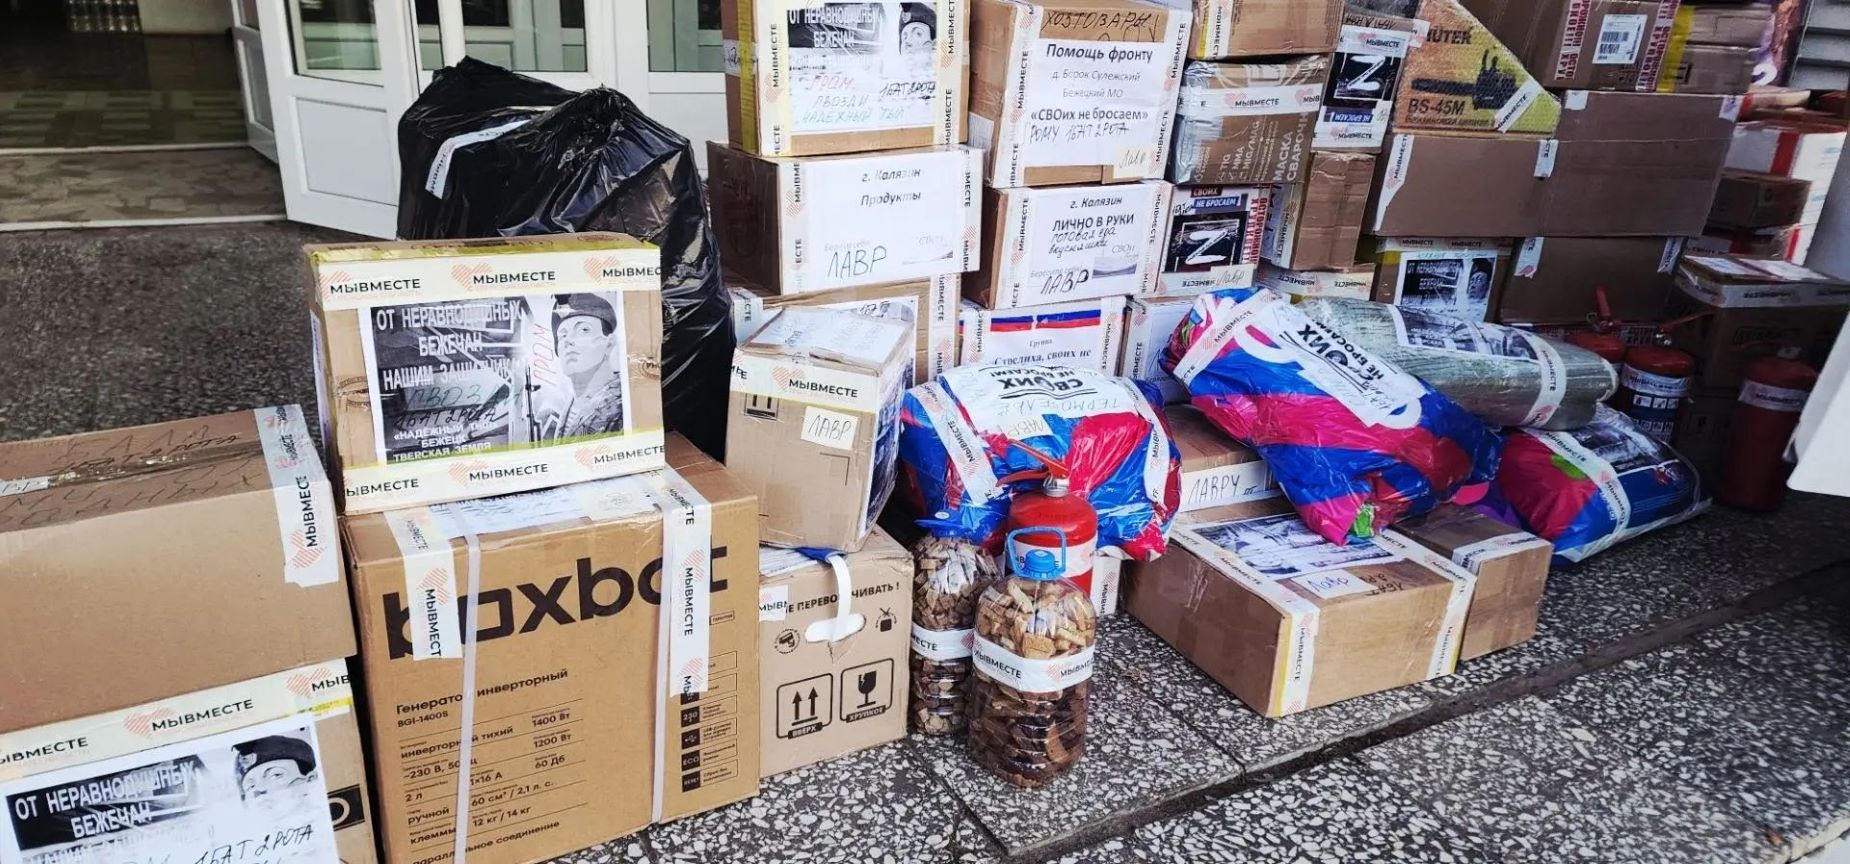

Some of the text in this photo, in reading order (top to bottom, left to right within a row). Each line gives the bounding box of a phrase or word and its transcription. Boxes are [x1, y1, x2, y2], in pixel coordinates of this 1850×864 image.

[1046, 43, 1154, 64] Помощь фронту
[1171, 22, 1187, 79] МЫВМЕСТЕ
[1366, 39, 1400, 48] МЫВМЕСТЕ
[771, 23, 780, 88] МЫВМЕСТЕ
[1017, 50, 1029, 109] МЫВМЕСТЕ
[1107, 89, 1125, 99] МО
[1234, 98, 1280, 107] МЫВМЕСТЕ
[1031, 106, 1149, 123] «СВОих не бросаем»
[1408, 98, 1466, 117] BS-45M
[1155, 109, 1170, 162] МЫВМЕСТЕ
[1243, 120, 1261, 171] MIG/MAG
[1220, 153, 1232, 171] TIG
[1231, 146, 1245, 170] MMA
[1273, 131, 1294, 182] МАСКА
[862, 172, 871, 183] г.
[860, 191, 922, 207] Продукты
[1070, 197, 1123, 209] г. Калязин
[1196, 199, 1206, 208] НЕ
[1018, 197, 1030, 251] МЫВМЕСТЕ
[1052, 213, 1135, 232] ЛИЧНО В РУКИ
[827, 245, 887, 280] ЛАВР
[330, 278, 421, 295] МЫВМЕСТЕ
[473, 271, 556, 285] МЫВМЕСТЕ
[1040, 269, 1090, 295] ЛАВР
[377, 309, 395, 331] ОТ
[1214, 311, 1254, 344] МЫВМЕСТЕ
[419, 332, 483, 357] БЕЖЕЧАН
[1029, 338, 1054, 349] Группа
[1049, 350, 1076, 361] своих
[1077, 348, 1092, 359] не
[382, 364, 434, 391] НАШИМ
[1366, 364, 1385, 380] НЕ
[788, 377, 859, 399] МЫВМЕСТЕ
[807, 414, 852, 441] ЛАВР
[421, 435, 467, 449] БЕЖЕЦК
[946, 420, 975, 464] МЫВМЕСТЕ
[393, 447, 451, 462] ТВЕРСКАЯ
[346, 478, 420, 497] ЫВМЕСТЕ
[469, 463, 549, 482] МЫВМЕСТЕ
[1190, 474, 1241, 505] ЛАВРУ
[1220, 557, 1262, 585] МЫВМЕСТЕ
[683, 566, 695, 637] МЫВМЕСТЕ
[797, 584, 895, 611] ПЕРЕВОЧИВАТЬ
[424, 588, 442, 658] МЫВМЕСТ
[974, 650, 1022, 680] МЫВМЕСТЕ
[396, 668, 569, 715] Генерато инверторный
[151, 698, 254, 732] МЫВМЕСТЕ
[398, 710, 449, 728] BGI-1400S
[532, 712, 571, 728] 1400 Вт
[0, 736, 89, 765] ЫВМЕСТЕ
[401, 735, 479, 759] инверторнй
[481, 725, 514, 740] тихий
[533, 733, 572, 749] 1200 Вт
[535, 754, 566, 769] 60 Дб
[494, 771, 503, 780] А
[15, 797, 38, 820] ОТ
[405, 792, 423, 803] 2 л
[471, 797, 486, 807] 60
[509, 788, 515, 801] /
[71, 801, 152, 839] БЕЖЕЧАН
[408, 806, 450, 825] ручной
[473, 805, 532, 828] 12 кг / 14 кг
[410, 826, 457, 845] клеммы
[496, 820, 560, 844] соединение
